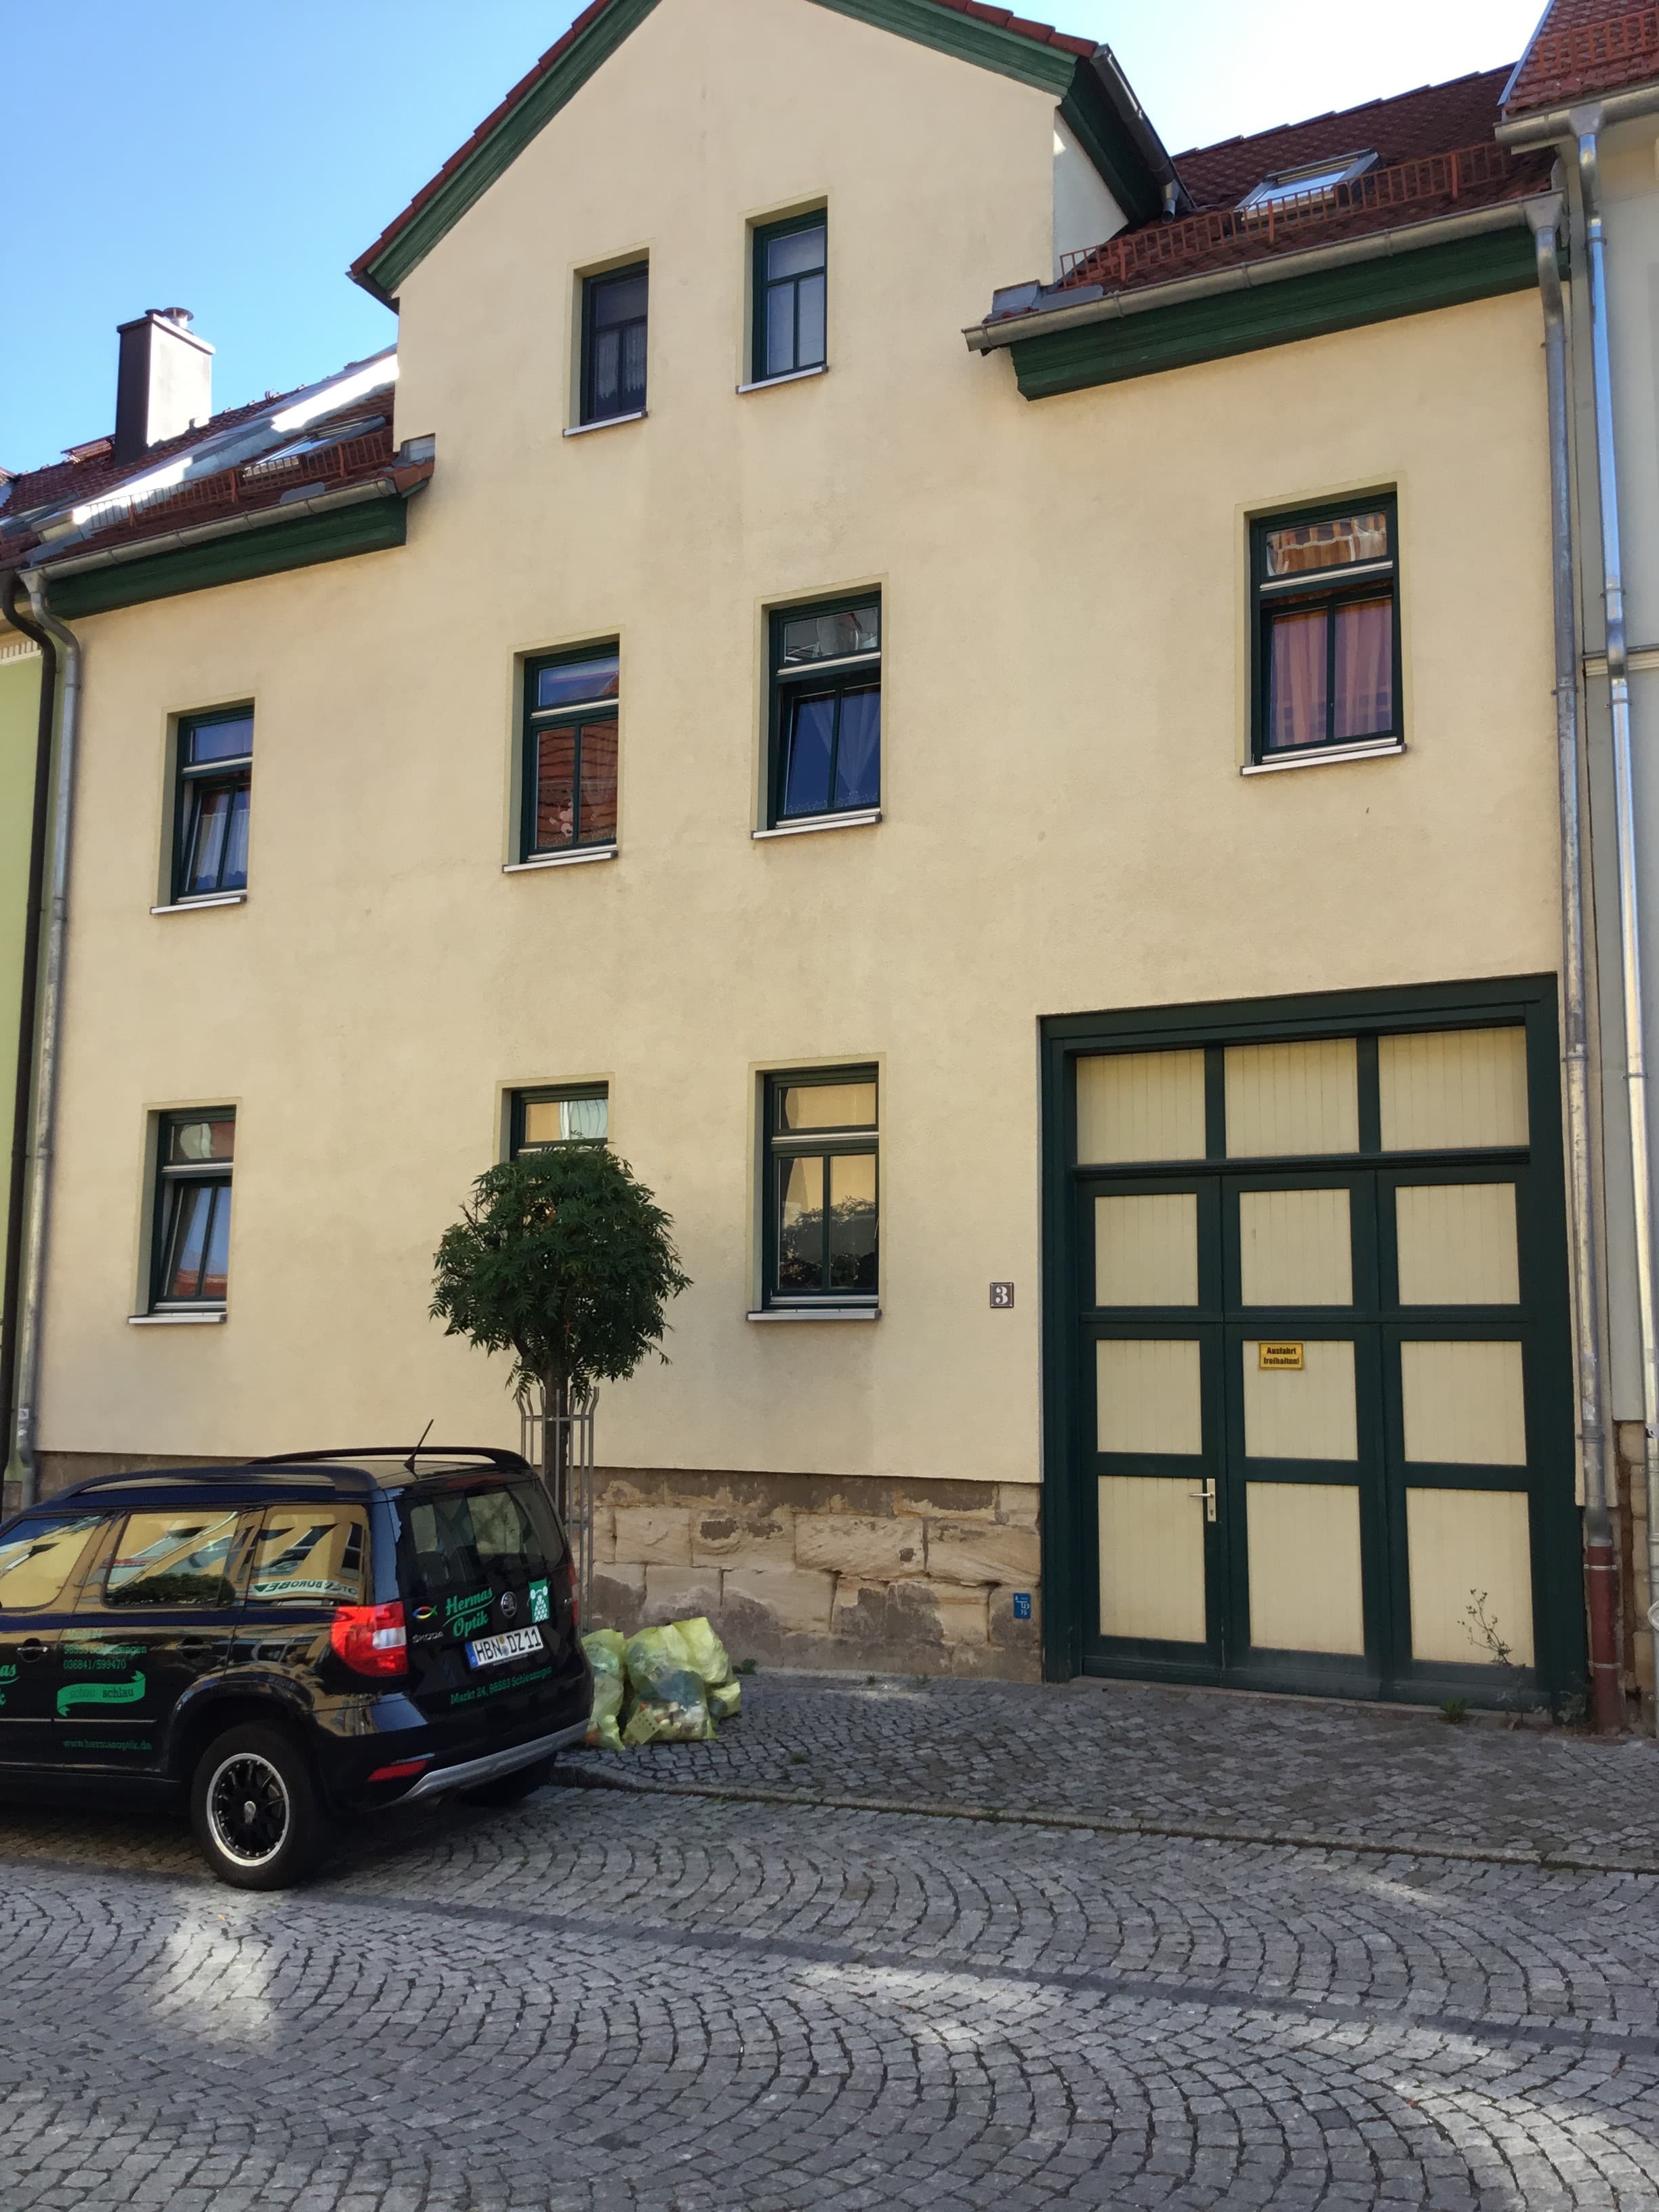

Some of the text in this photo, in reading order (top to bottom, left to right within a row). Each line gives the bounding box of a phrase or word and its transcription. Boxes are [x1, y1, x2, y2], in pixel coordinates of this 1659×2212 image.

[996, 1286, 1008, 1305] 3
[1266, 1347, 1297, 1355] Ausfahrt
[1263, 1357, 1300, 1365] freihalten!
[445, 1586, 493, 1616] Hermas
[453, 1610, 489, 1637] Optik
[474, 1637, 503, 1662] HBN
[506, 1632, 526, 1654] DZ
[524, 1628, 541, 1649] 11
[63, 1658, 127, 1670] 036841/599470
[102, 1685, 135, 1698] schlau
[450, 1689, 475, 1704] Markt
